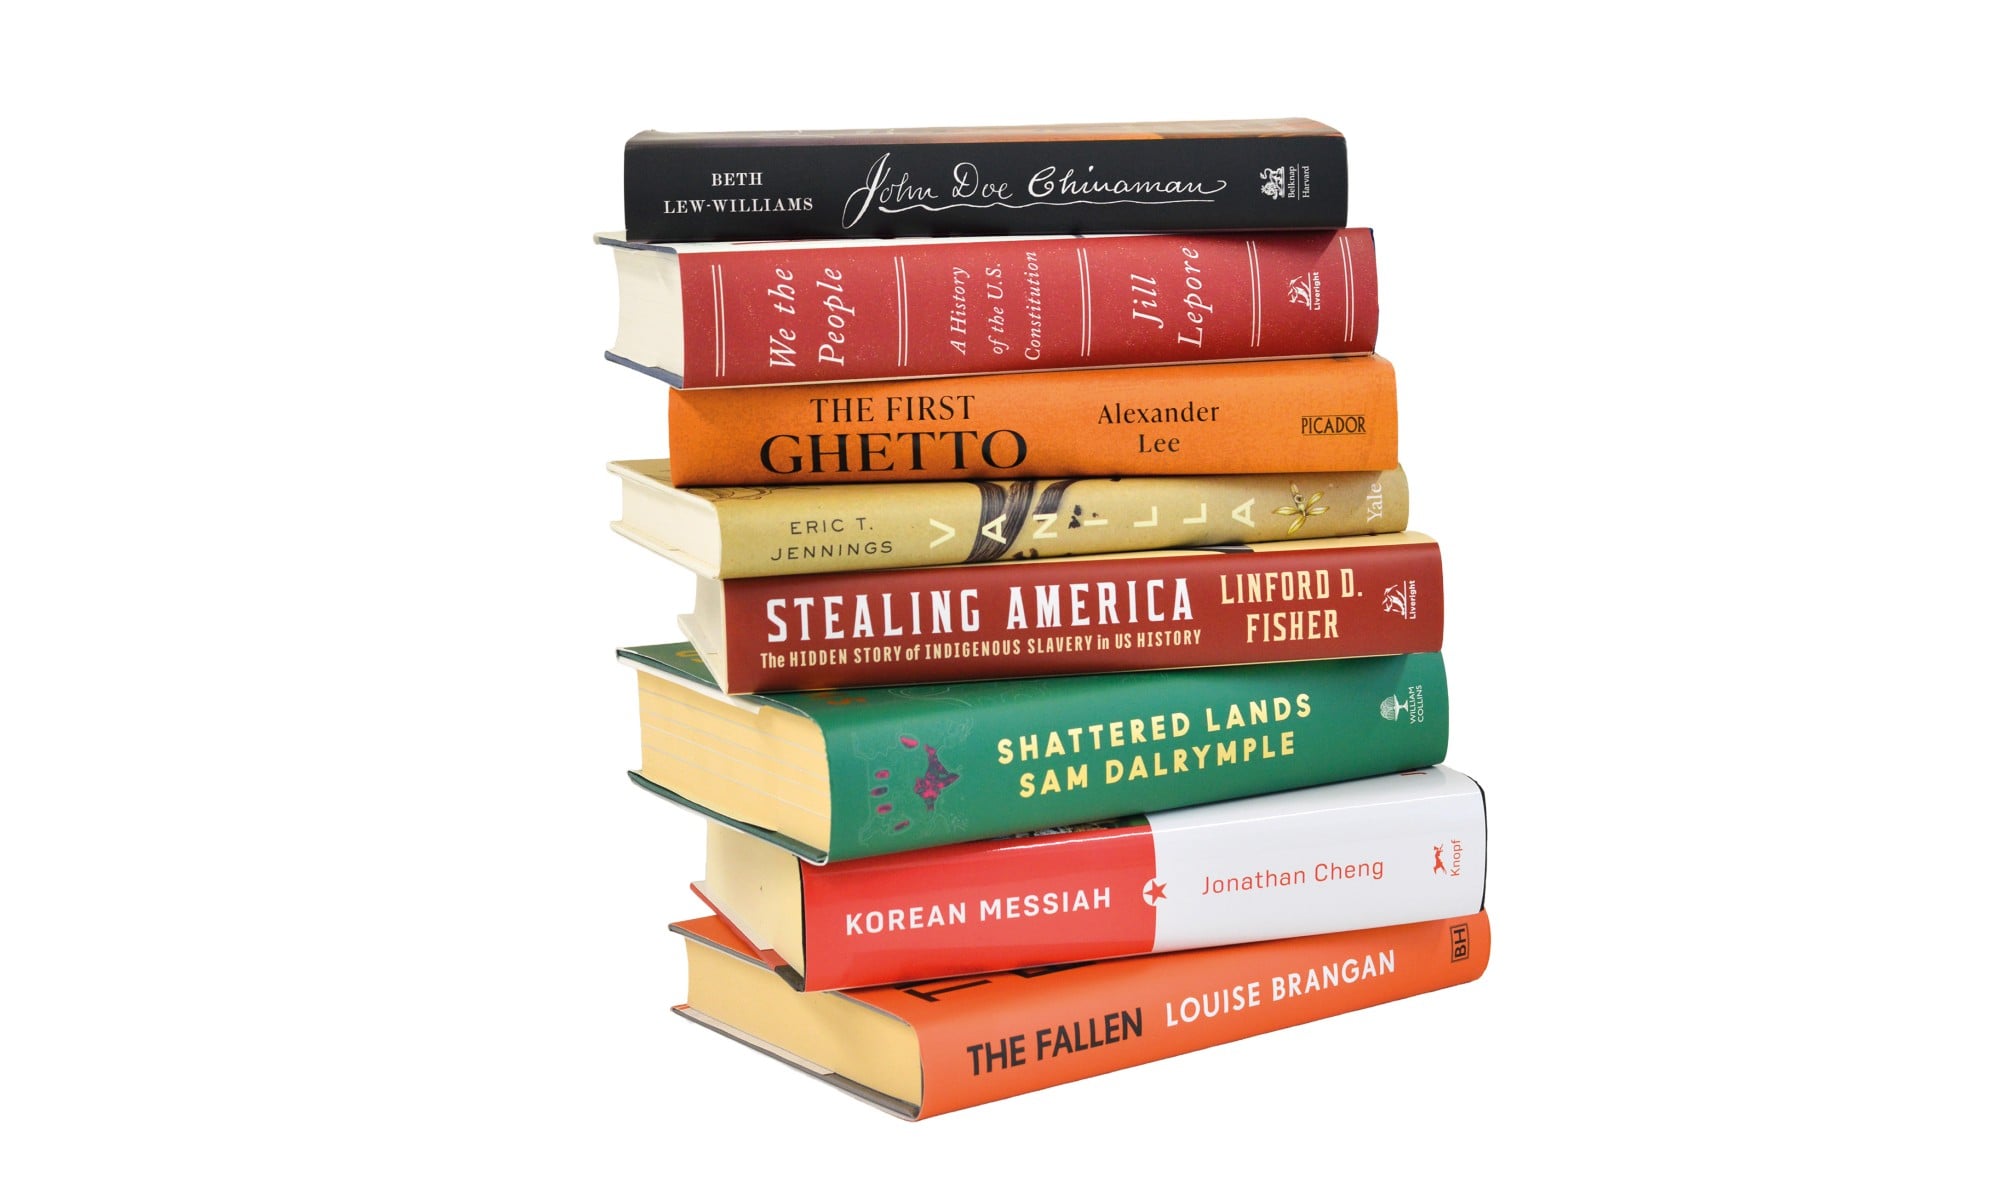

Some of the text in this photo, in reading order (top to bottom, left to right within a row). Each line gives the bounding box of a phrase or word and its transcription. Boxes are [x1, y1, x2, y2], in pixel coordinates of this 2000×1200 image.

[711, 173, 763, 187] BETH
[842, 152, 1227, 229] John Doe Chinaman
[1287, 166, 1297, 198] Belknap
[1302, 165, 1310, 198] Harvard
[664, 197, 813, 214] LEW-WILLIAMS
[986, 263, 1010, 355] of the U.S.
[1024, 251, 1042, 361] Constitution
[1131, 273, 1164, 329] Jill
[1177, 247, 1213, 348] Lepore
[1313, 271, 1321, 310] Liveright
[768, 268, 797, 367] We the
[819, 267, 855, 365] People
[950, 266, 970, 355] A History
[810, 395, 975, 423] THE FIRST
[1098, 402, 1219, 424] Alexander
[1301, 416, 1366, 434] PICADOR
[760, 429, 1028, 475] GHETTO
[1138, 434, 1180, 454] Lee
[1366, 482, 1382, 521] Yale
[790, 517, 873, 535] ERIC T.
[771, 541, 892, 561] JENNINGS
[1220, 567, 1364, 605] LINFORD D.
[1409, 579, 1417, 621] Liveright
[766, 577, 1193, 643] STEALING AMERICA
[1247, 609, 1339, 643] FISHER
[760, 629, 1202, 669] The HIDDEN STORY of INDIGENOUS SLAVERY in US HISTORY
[997, 692, 1312, 766] SHATTERED LANDS
[1019, 731, 1295, 799] SAM DALRYMPLE
[1450, 838, 1463, 877] Knopf
[1201, 859, 1385, 897] Jonathan Cheng
[845, 886, 1111, 937] KOREAN MESSIAH
[1454, 926, 1468, 958] BH
[1165, 948, 1396, 1028] LOUISE BRANGAN
[966, 1007, 1142, 1077] THE FALLEN
